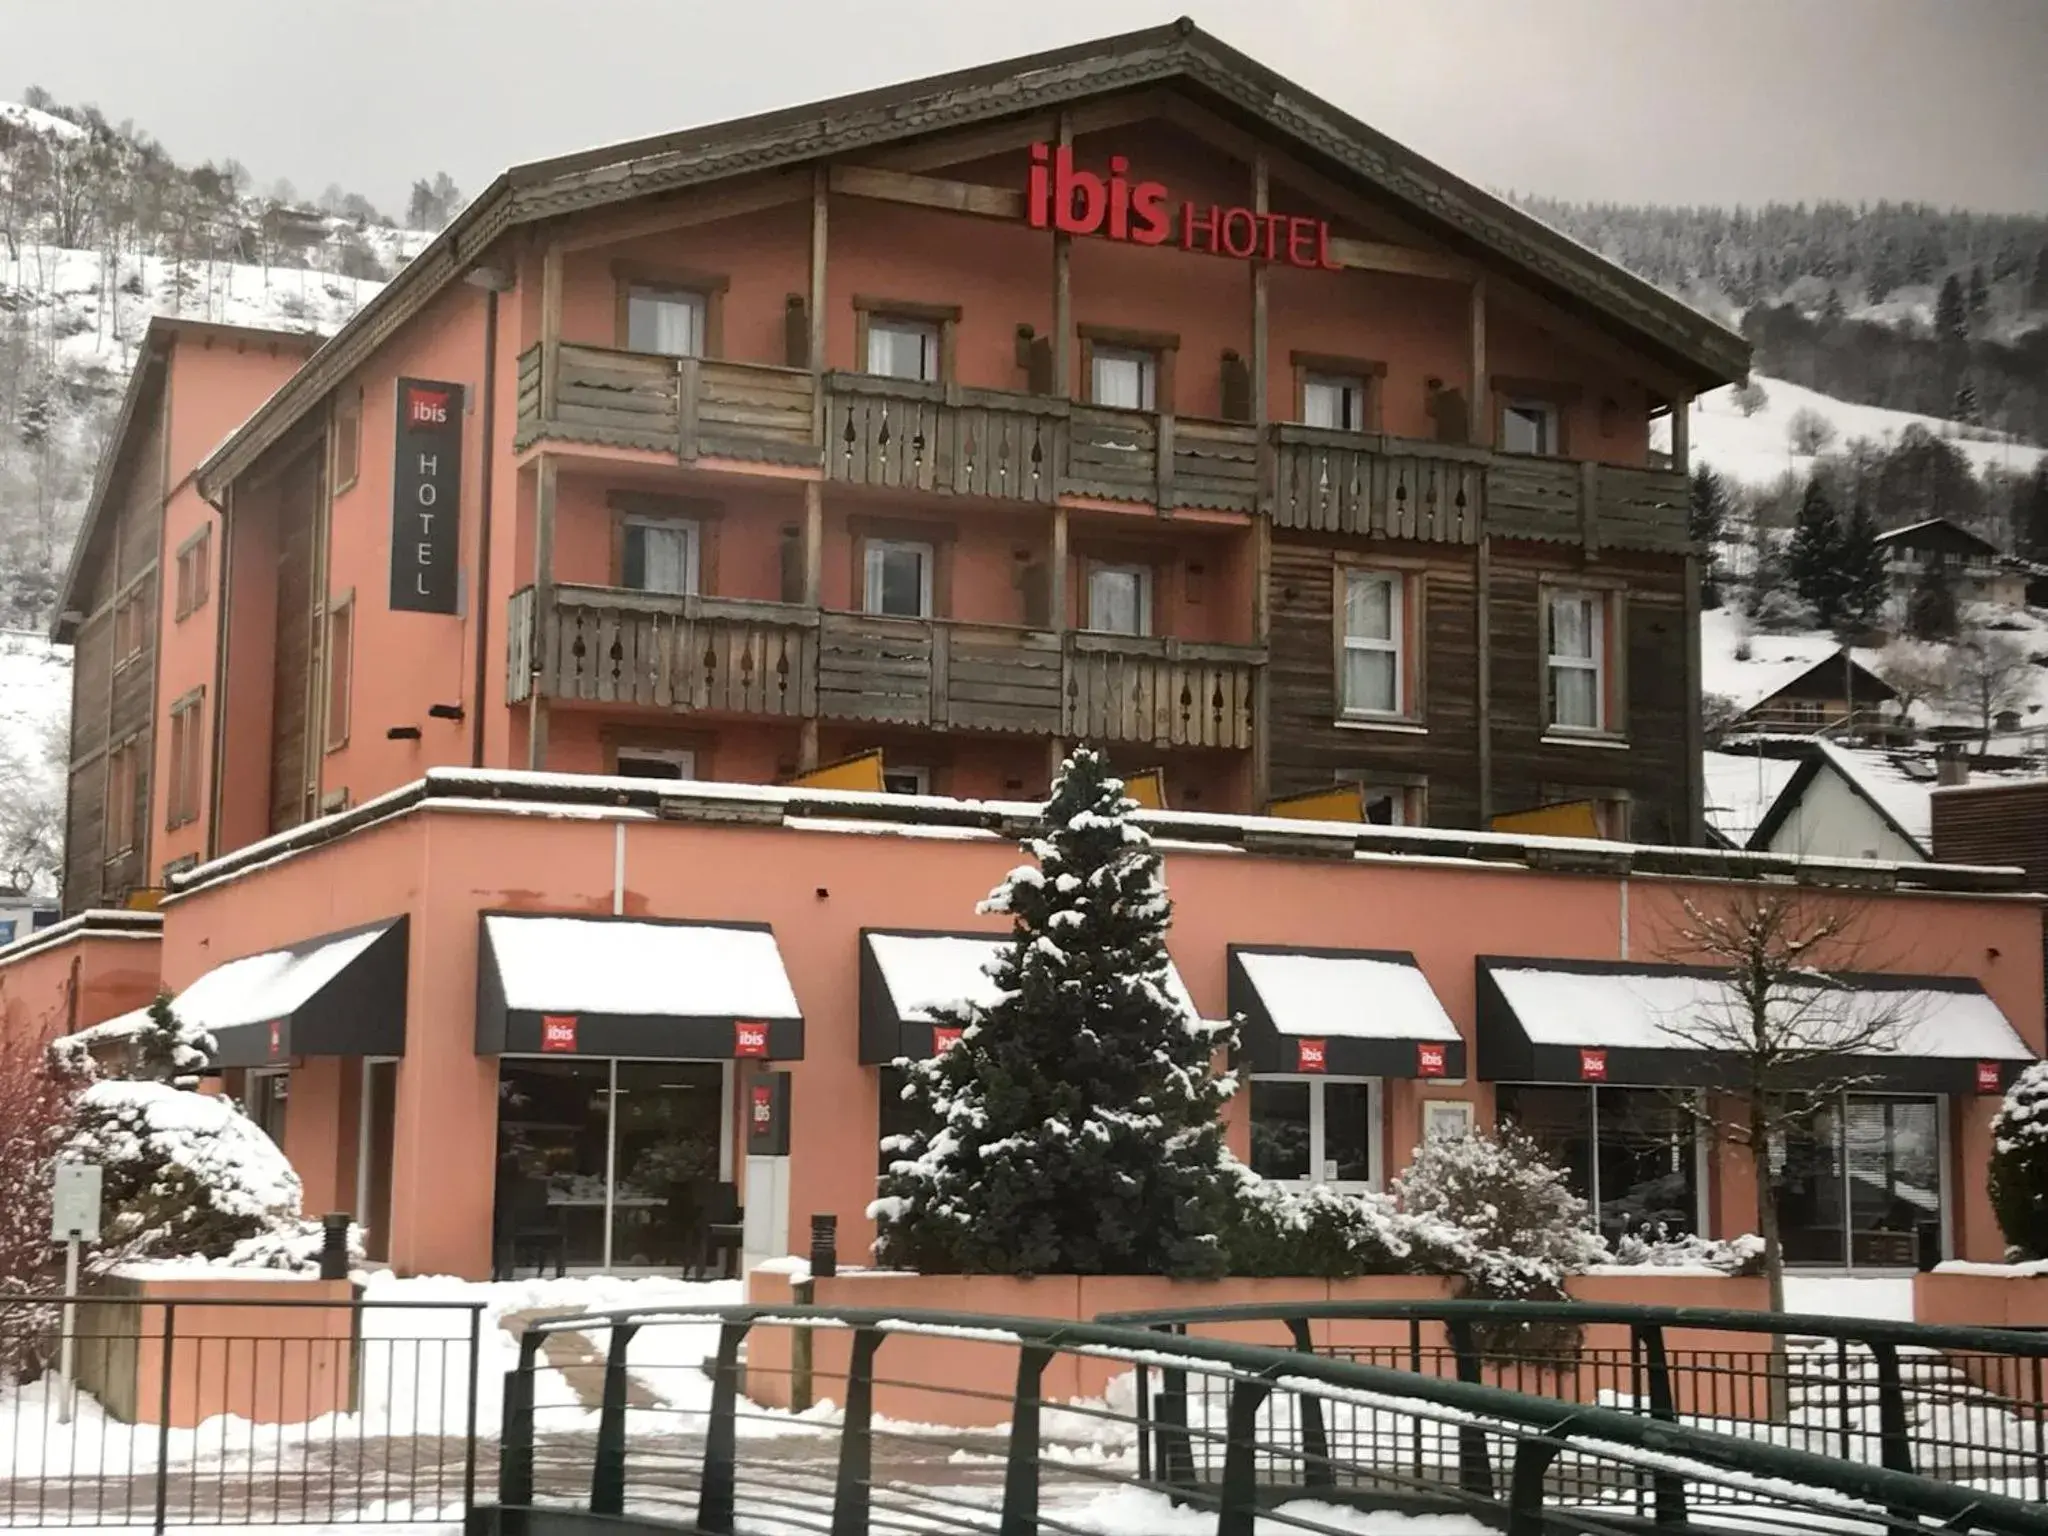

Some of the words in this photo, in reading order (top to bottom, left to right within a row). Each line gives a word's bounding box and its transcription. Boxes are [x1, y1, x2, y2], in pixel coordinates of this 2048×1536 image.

[1027, 140, 1172, 245] ibis
[1181, 201, 1344, 270] HOTEL
[412, 400, 447, 424] ibis
[416, 453, 438, 595] HOTEL
[547, 1024, 574, 1041] ibis
[739, 1030, 764, 1046] ibis
[1301, 1046, 1323, 1061] ibis
[1421, 1051, 1443, 1066] ibis
[1583, 1057, 1604, 1071] ibis
